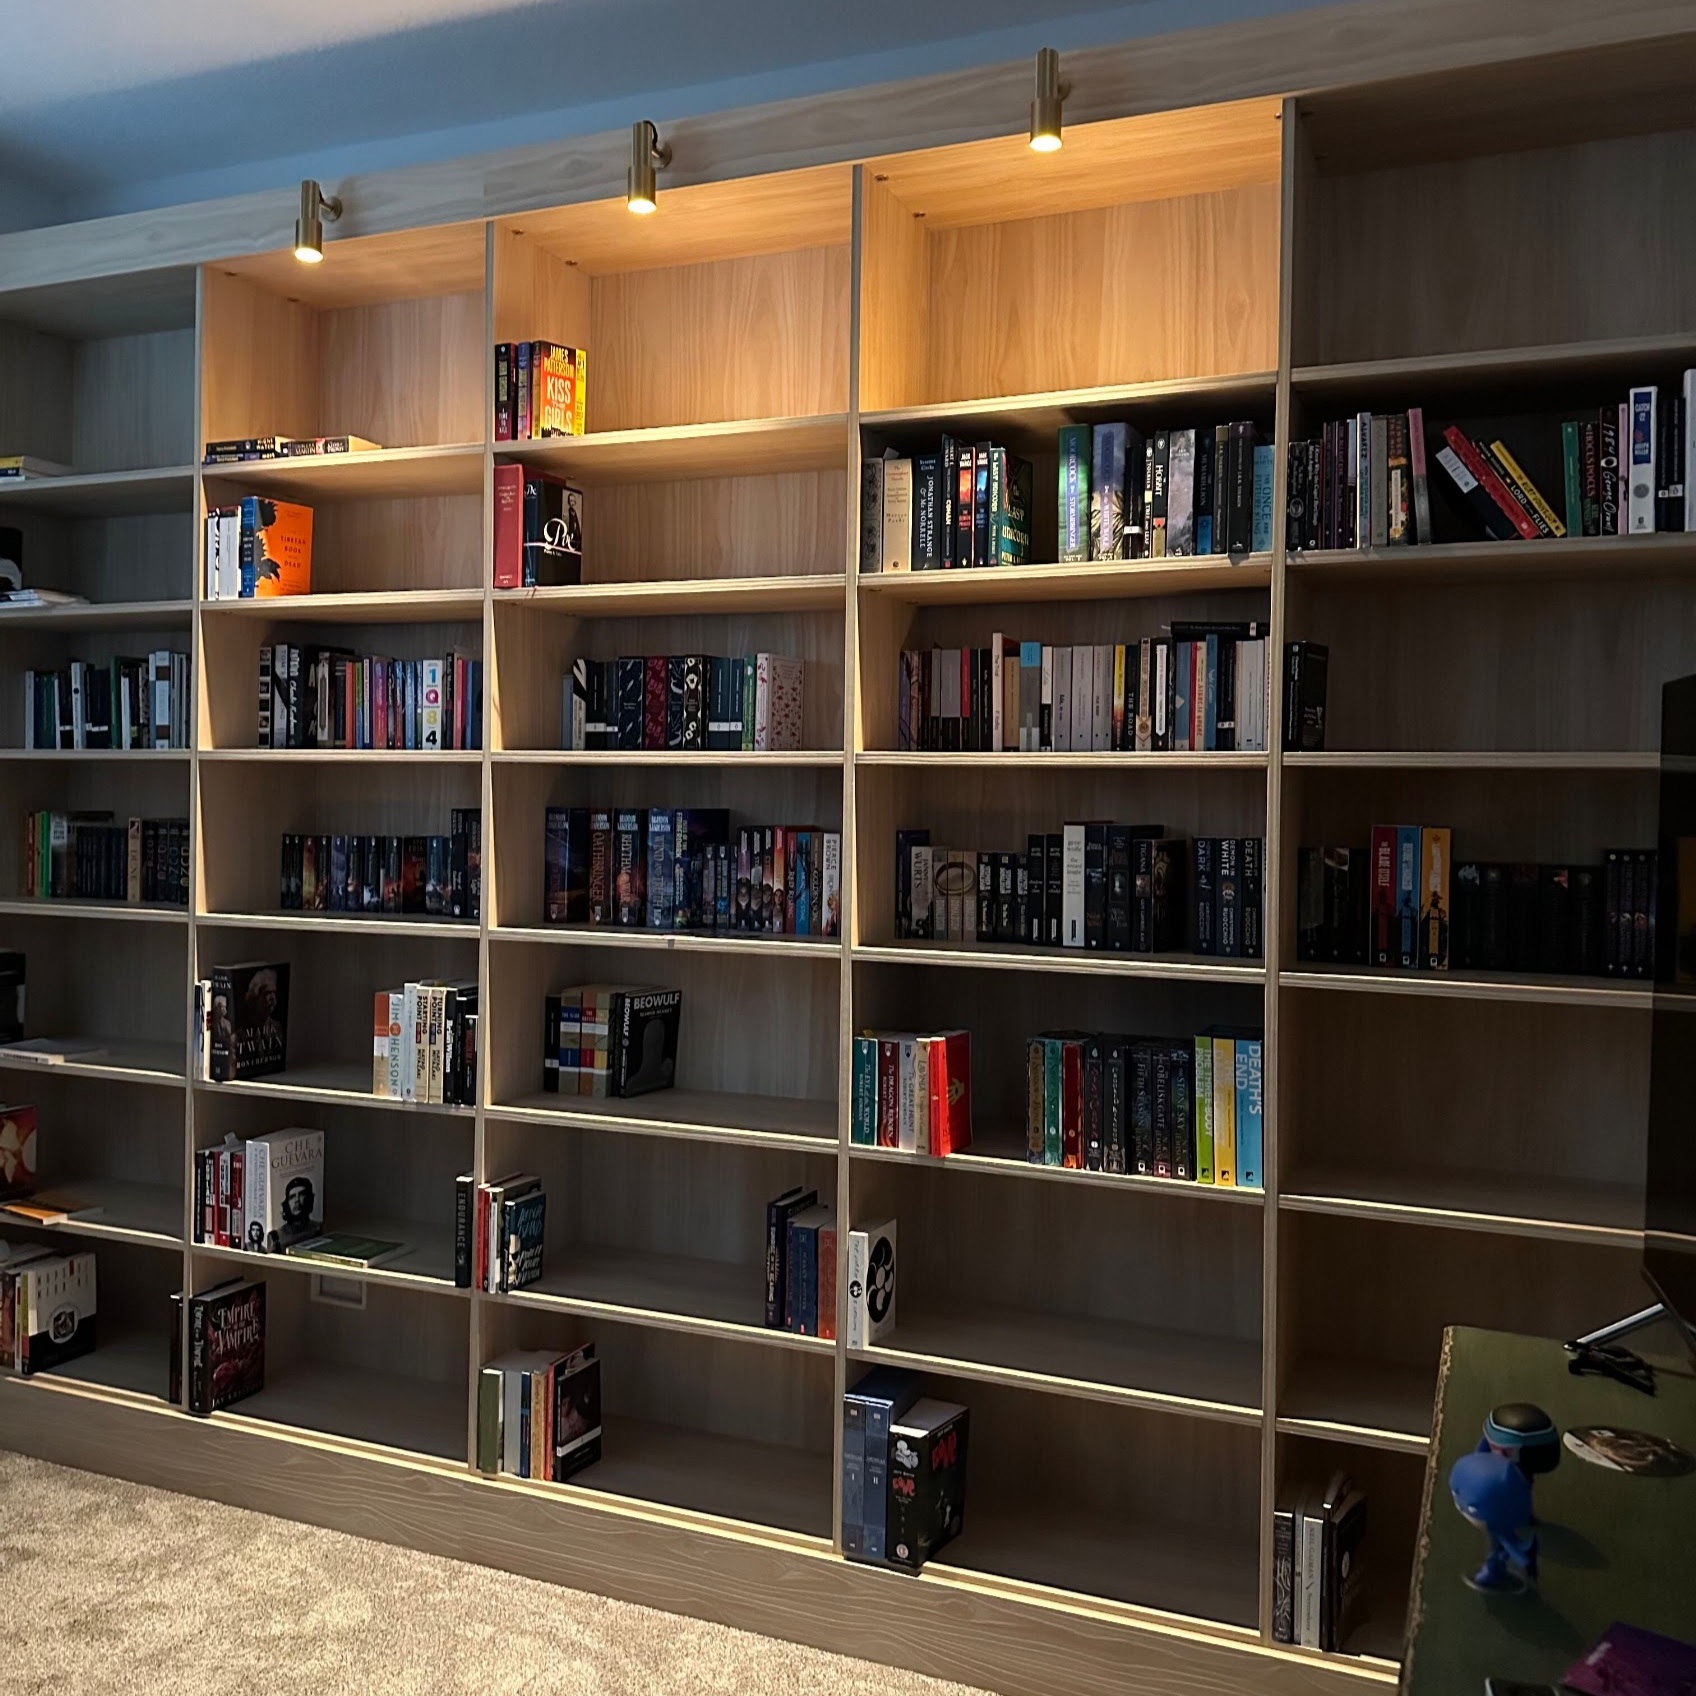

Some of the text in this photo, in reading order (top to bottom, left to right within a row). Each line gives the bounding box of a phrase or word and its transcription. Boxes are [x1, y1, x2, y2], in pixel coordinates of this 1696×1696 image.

[544, 357, 574, 378] PATTERSON
[550, 345, 568, 363] JAMES
[547, 376, 571, 404] KISS
[545, 406, 572, 431] GIRLS
[1634, 403, 1651, 412] CATCH
[1603, 423, 1616, 454] 1984
[1586, 431, 1596, 497] HOCUS POCUS
[1155, 465, 1164, 497] HOBBIT
[1511, 485, 1527, 504] LORD
[1008, 504, 1025, 521] LAST
[1262, 487, 1272, 520] ONCE
[1602, 471, 1617, 533] George Orwell
[1002, 525, 1029, 545] UNICORN
[1532, 513, 1550, 534] FLIES
[281, 535, 306, 545] TIBETAN
[284, 560, 301, 568] DEAD
[592, 832, 605, 902] OATHBRINGER
[913, 851, 923, 889] WURTS
[1198, 840, 1206, 872] DARK
[1221, 840, 1230, 876] WHITE
[1244, 840, 1253, 877] DEATH
[633, 992, 680, 1010] BEOWULF
[246, 1024, 277, 1038] MARK
[622, 998, 630, 1036] BEOWULF
[237, 1036, 283, 1055] TWAIN
[390, 1000, 400, 1086] JIM HENSON
[1204, 1049, 1212, 1068] THE
[1195, 1048, 1204, 1097] PROBLEM
[1236, 1053, 1248, 1090] END
[1249, 1045, 1262, 1114] DEATH'S
[1137, 1063, 1145, 1125] FIFTH SEASON
[1156, 1065, 1165, 1128] OBELISK GATE
[1176, 1077, 1185, 1130] STONE SKY
[271, 1148, 323, 1169] GUEVARA
[285, 1139, 309, 1154] CHE
[457, 1192, 466, 1248] ENDURANCE
[217, 1301, 256, 1329] EMPIRE
[214, 1319, 260, 1357] VAMPIRE
